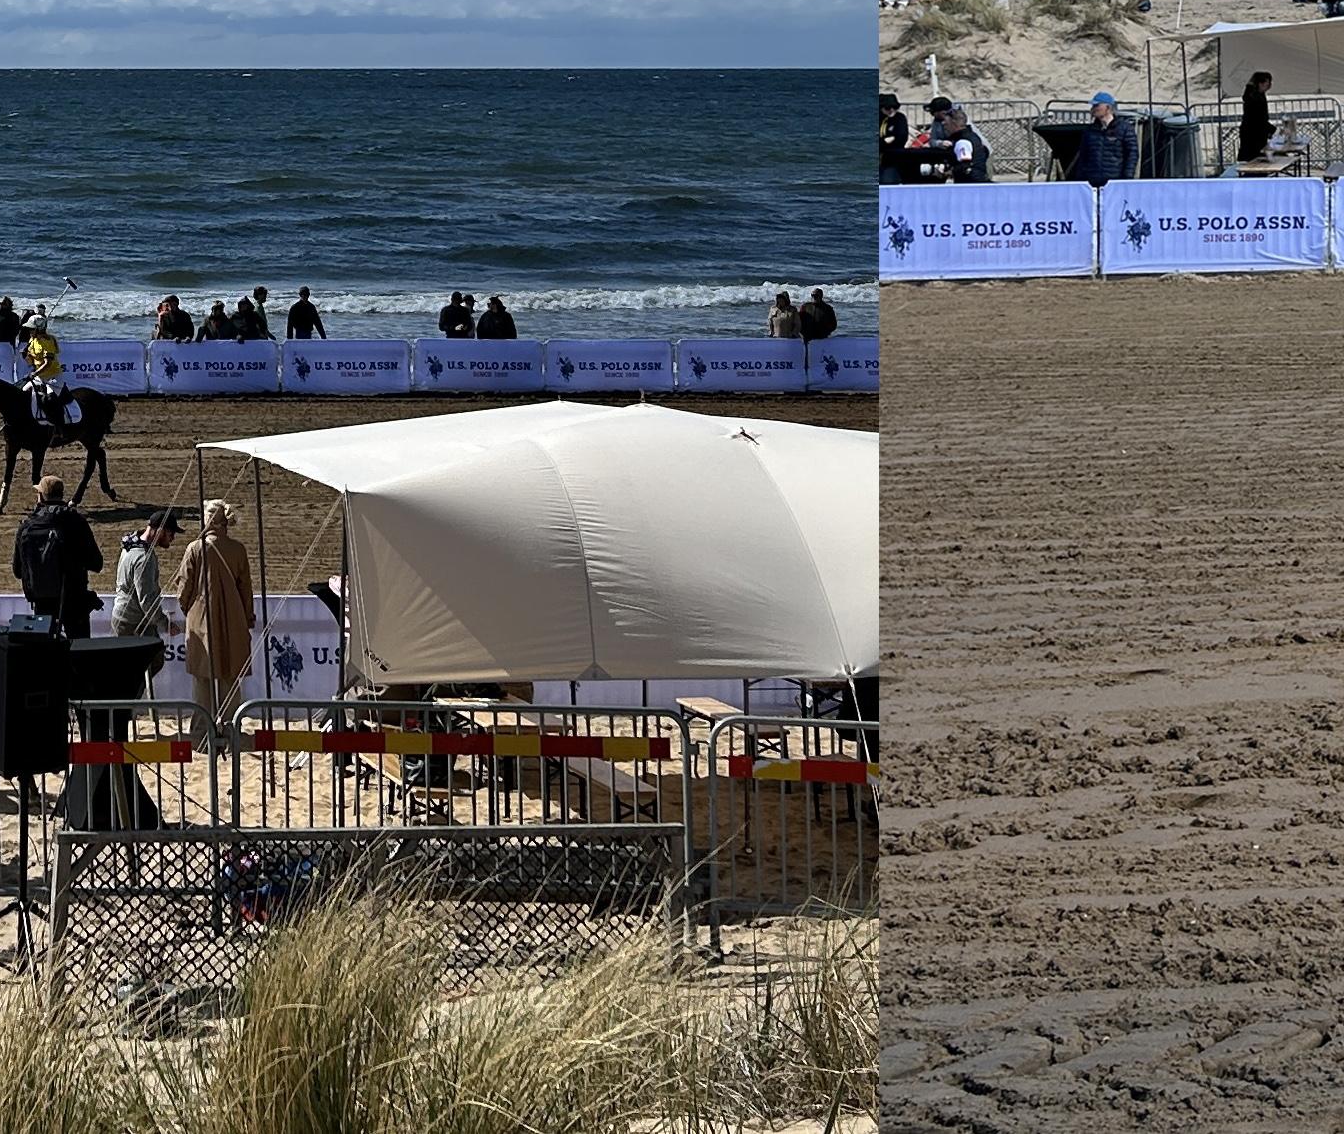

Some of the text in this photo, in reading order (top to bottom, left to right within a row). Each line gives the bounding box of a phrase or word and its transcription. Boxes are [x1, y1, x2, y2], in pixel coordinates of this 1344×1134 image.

[1159, 216, 1310, 231] U.S. POLO ASSN.
[923, 221, 1077, 238] U.S. POLO ASSN.
[1203, 233, 1265, 243] SINCE 1890
[968, 240, 1031, 249] SINCE 1890
[73, 363, 101, 372] POLO
[205, 361, 233, 371] POLO
[337, 361, 366, 370] POLO
[470, 361, 499, 370] POLO
[601, 361, 630, 370] POLO
[733, 361, 761, 370] POLO
[865, 360, 879, 369] PO
